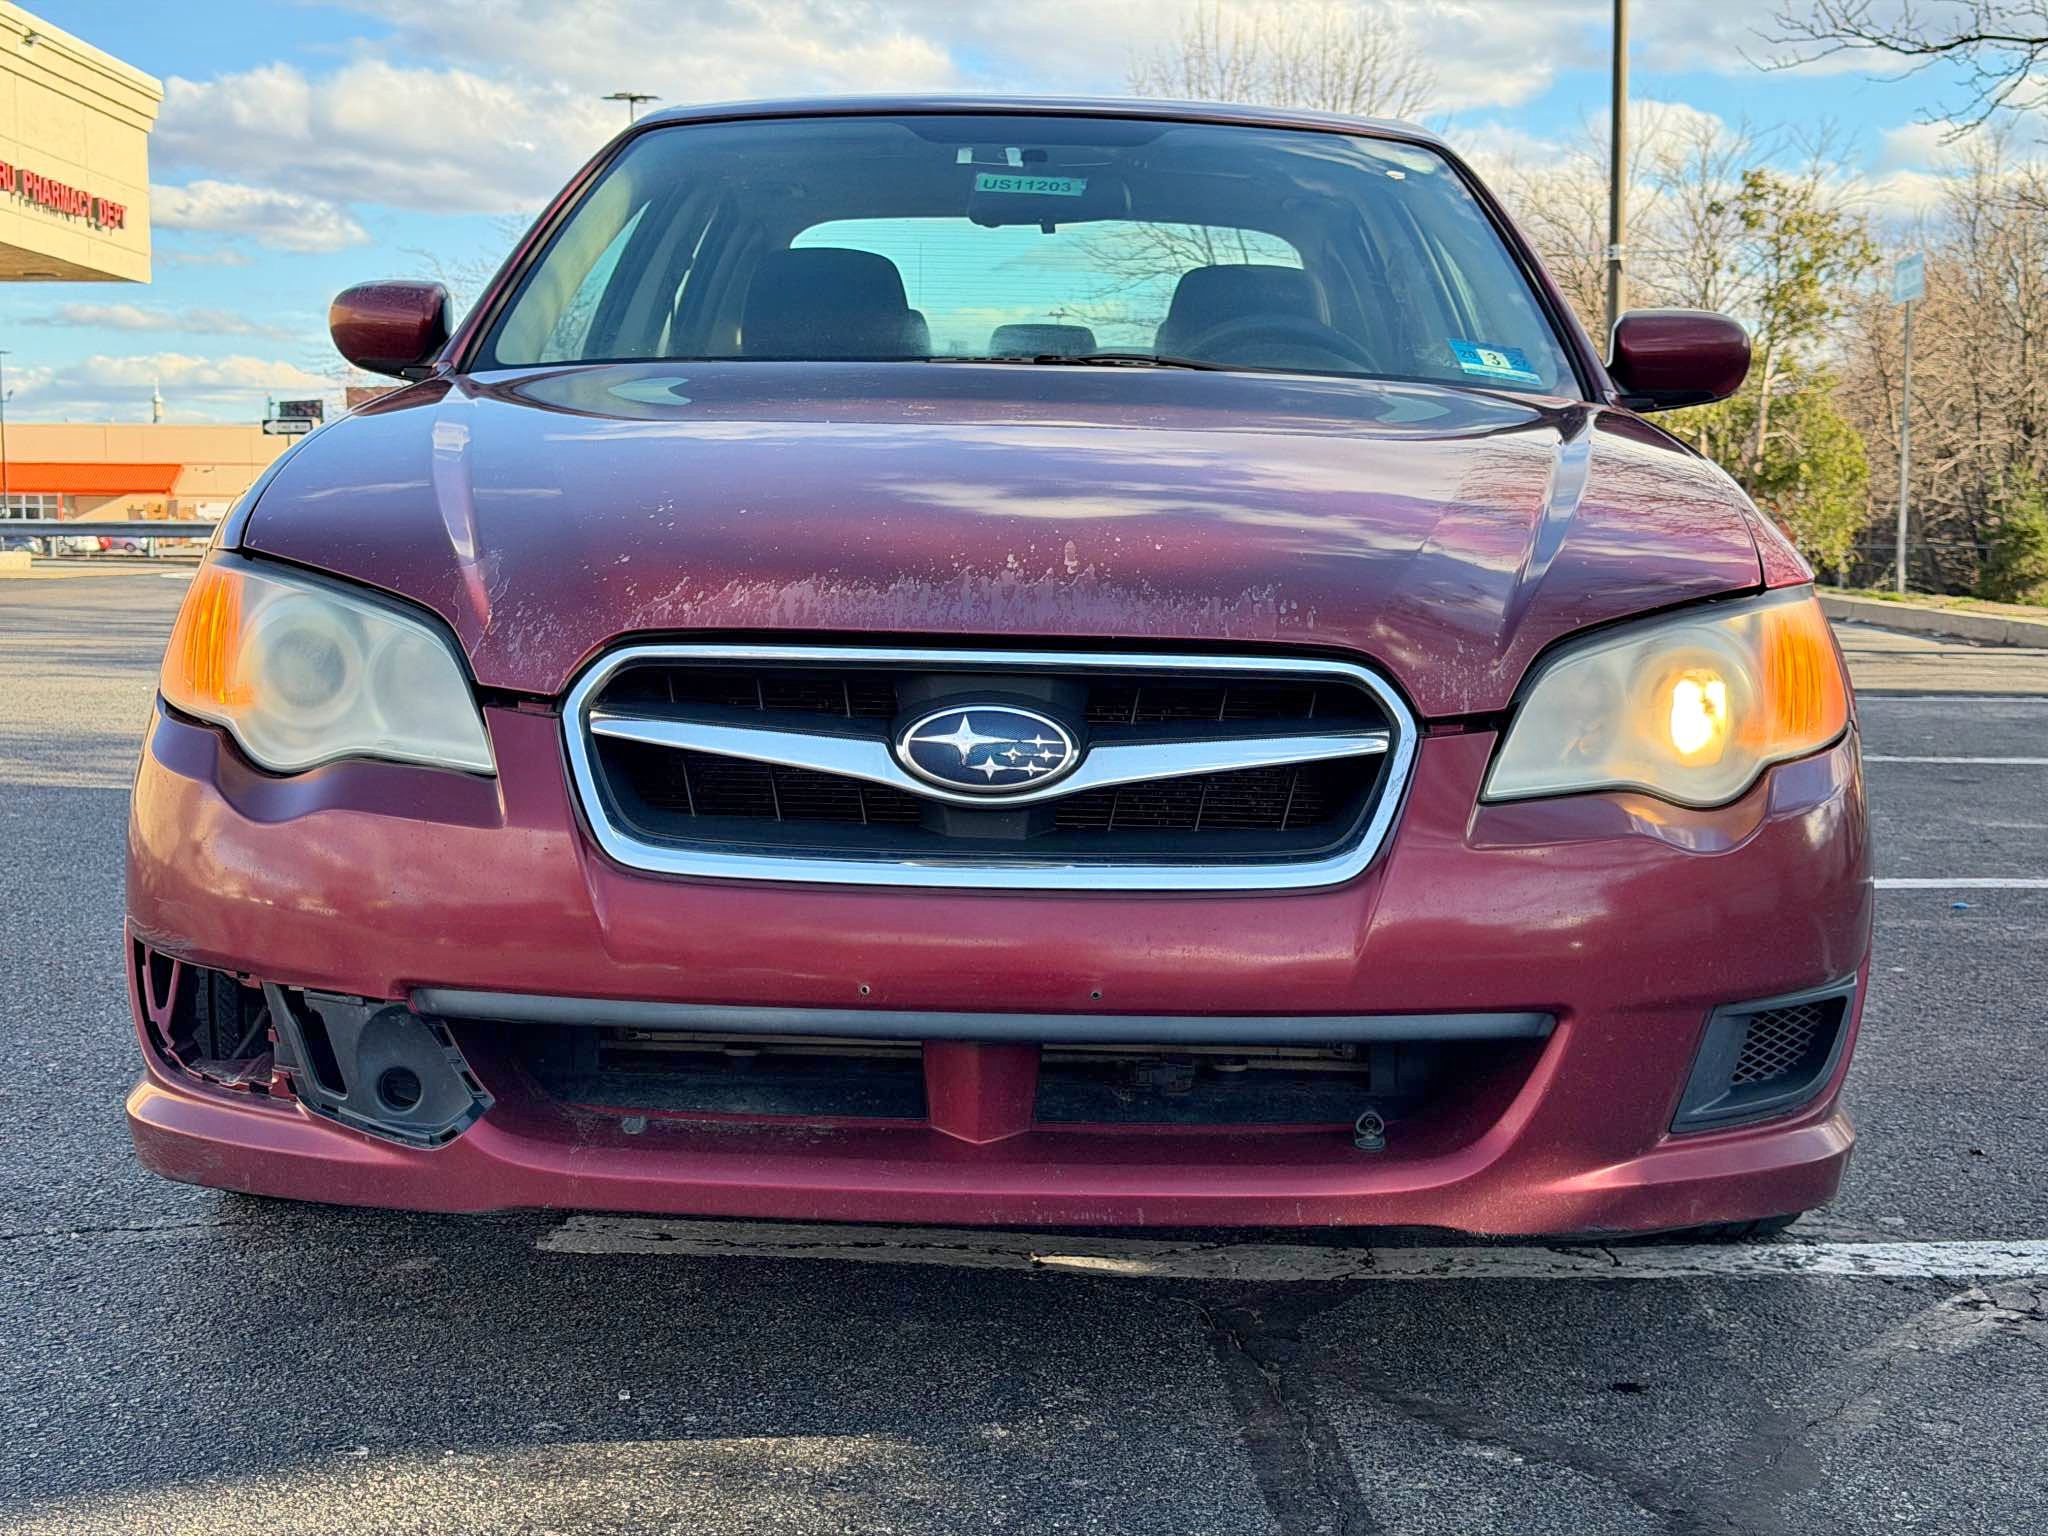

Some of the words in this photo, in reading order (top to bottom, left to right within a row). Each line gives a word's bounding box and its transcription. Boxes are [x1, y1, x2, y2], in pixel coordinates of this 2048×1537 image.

[983, 178, 1072, 193] US11203
[0, 160, 17, 194] RU
[22, 169, 93, 218] PHARMACY
[98, 197, 127, 230] DEPT
[1487, 352, 1501, 366] 3
